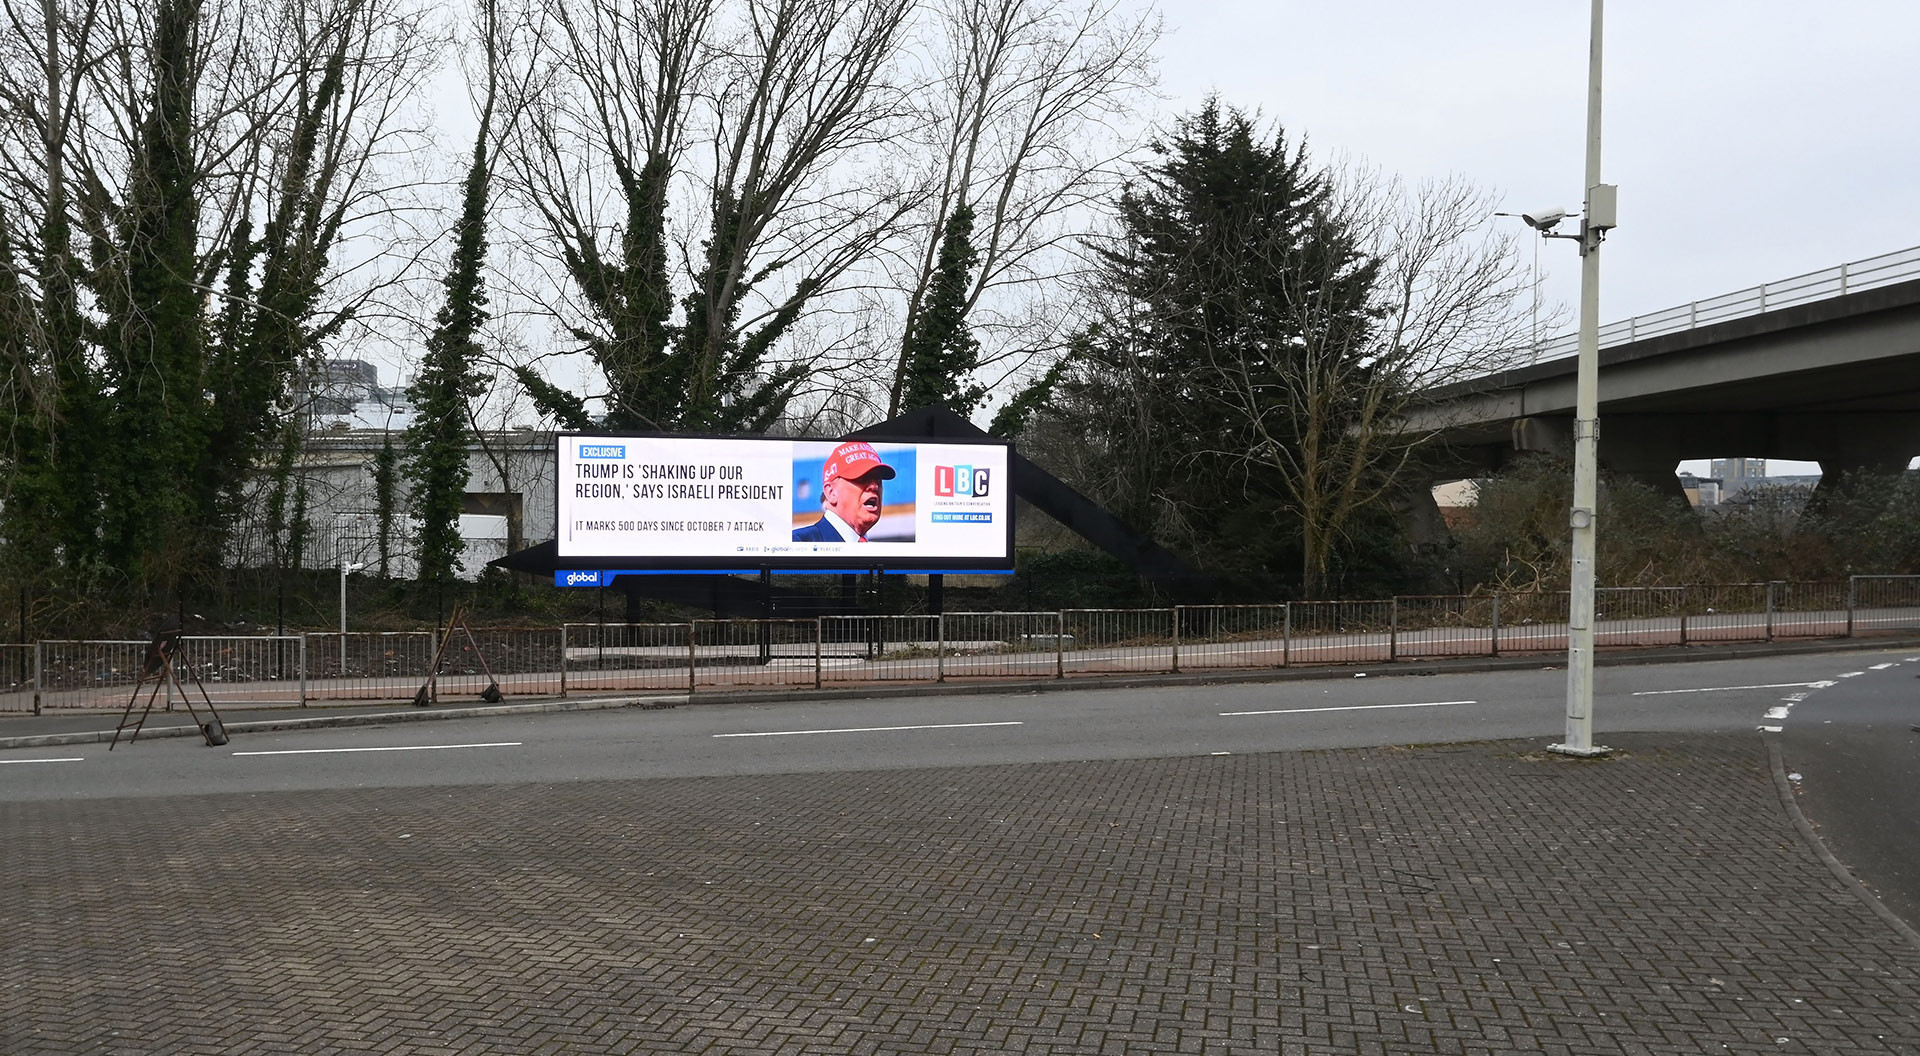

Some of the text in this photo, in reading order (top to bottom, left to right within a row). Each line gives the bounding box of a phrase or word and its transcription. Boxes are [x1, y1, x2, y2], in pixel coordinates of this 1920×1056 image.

[583, 447, 623, 457] EXCLUSIVE
[839, 444, 859, 457] MAKE
[845, 452, 867, 464] GREAT
[575, 464, 743, 480] TRUMP IS 'SHAKING UP OUR
[938, 466, 988, 497] LBC
[575, 483, 783, 500] REGION,' SAYS ISRAELI PRESIDENT
[575, 521, 764, 531] IT MARKS 500 DAYS SINCE OCTOBER 7 ATTACK
[567, 572, 597, 585] global
